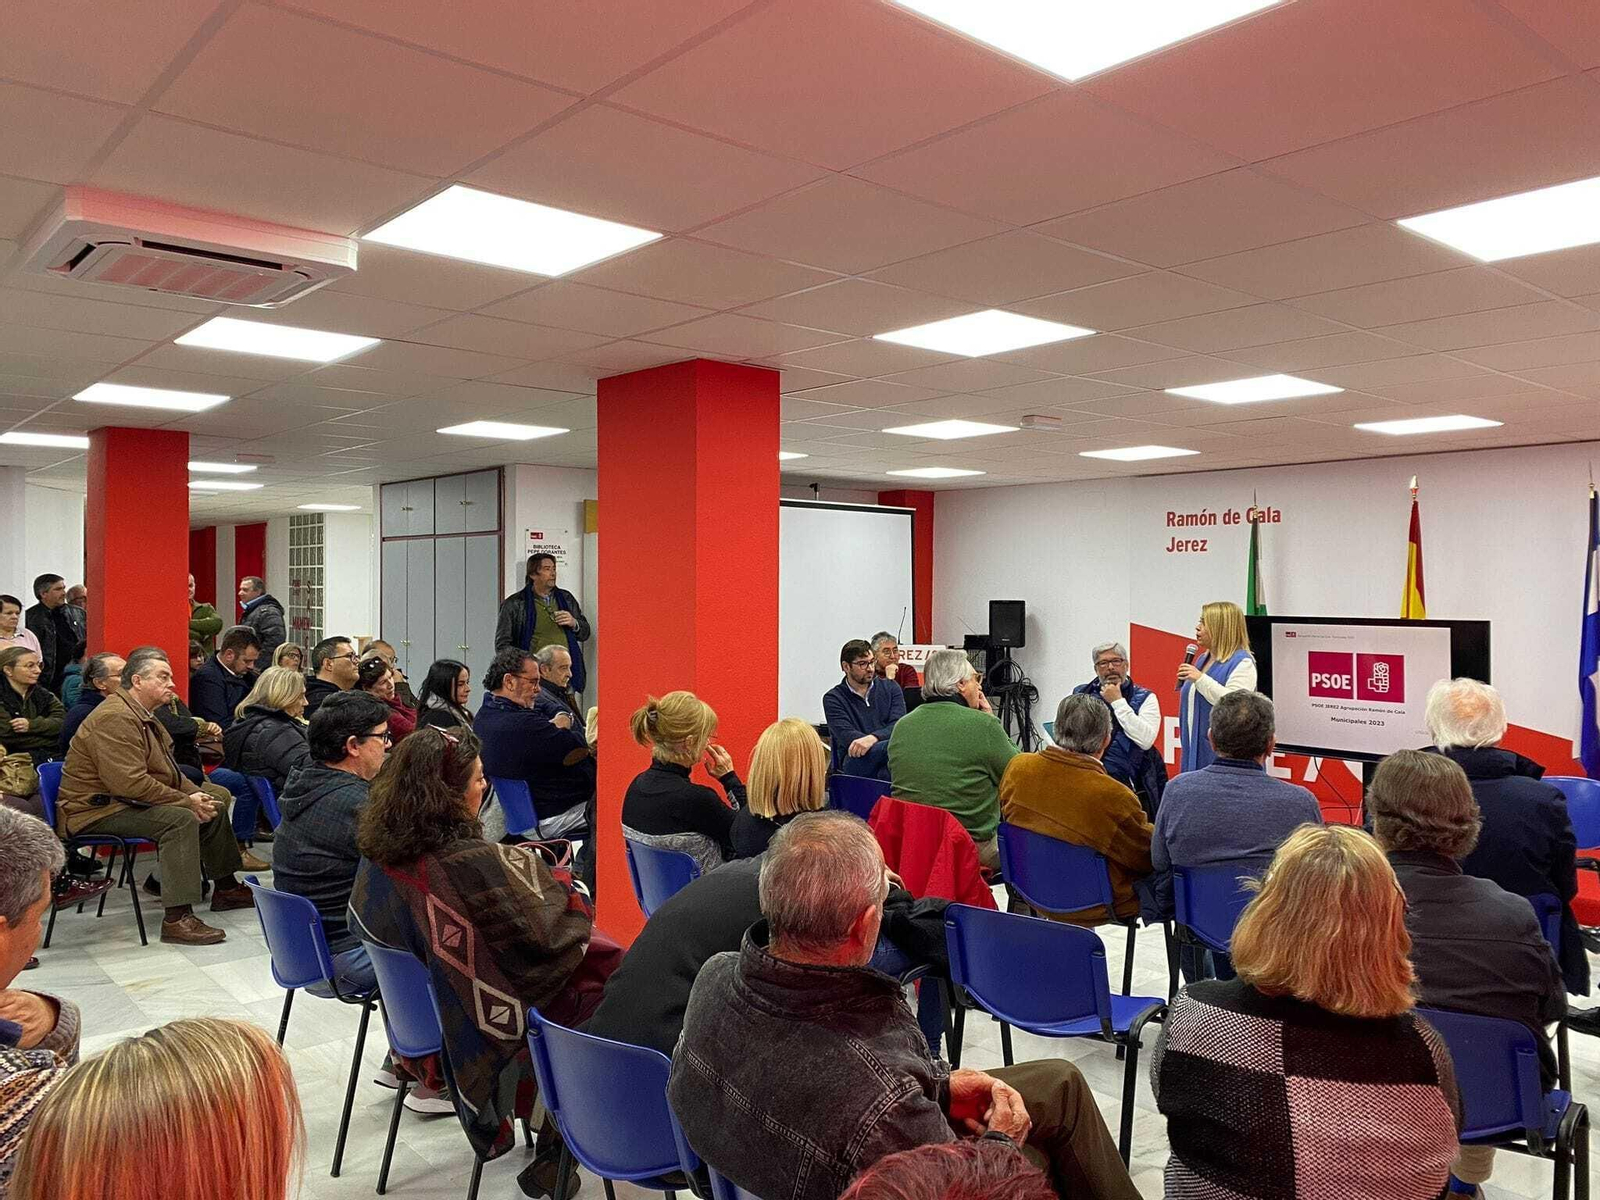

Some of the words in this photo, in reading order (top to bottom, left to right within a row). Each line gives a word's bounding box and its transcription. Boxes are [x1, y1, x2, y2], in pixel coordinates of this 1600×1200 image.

[1166, 509, 1217, 527] Ramón
[1223, 508, 1241, 525] de
[1246, 506, 1281, 524] Cala
[1166, 537, 1207, 552] Jerez
[1311, 673, 1351, 690] PSOE
[1331, 716, 1367, 725] Municipales
[1369, 719, 1385, 727] 2023
